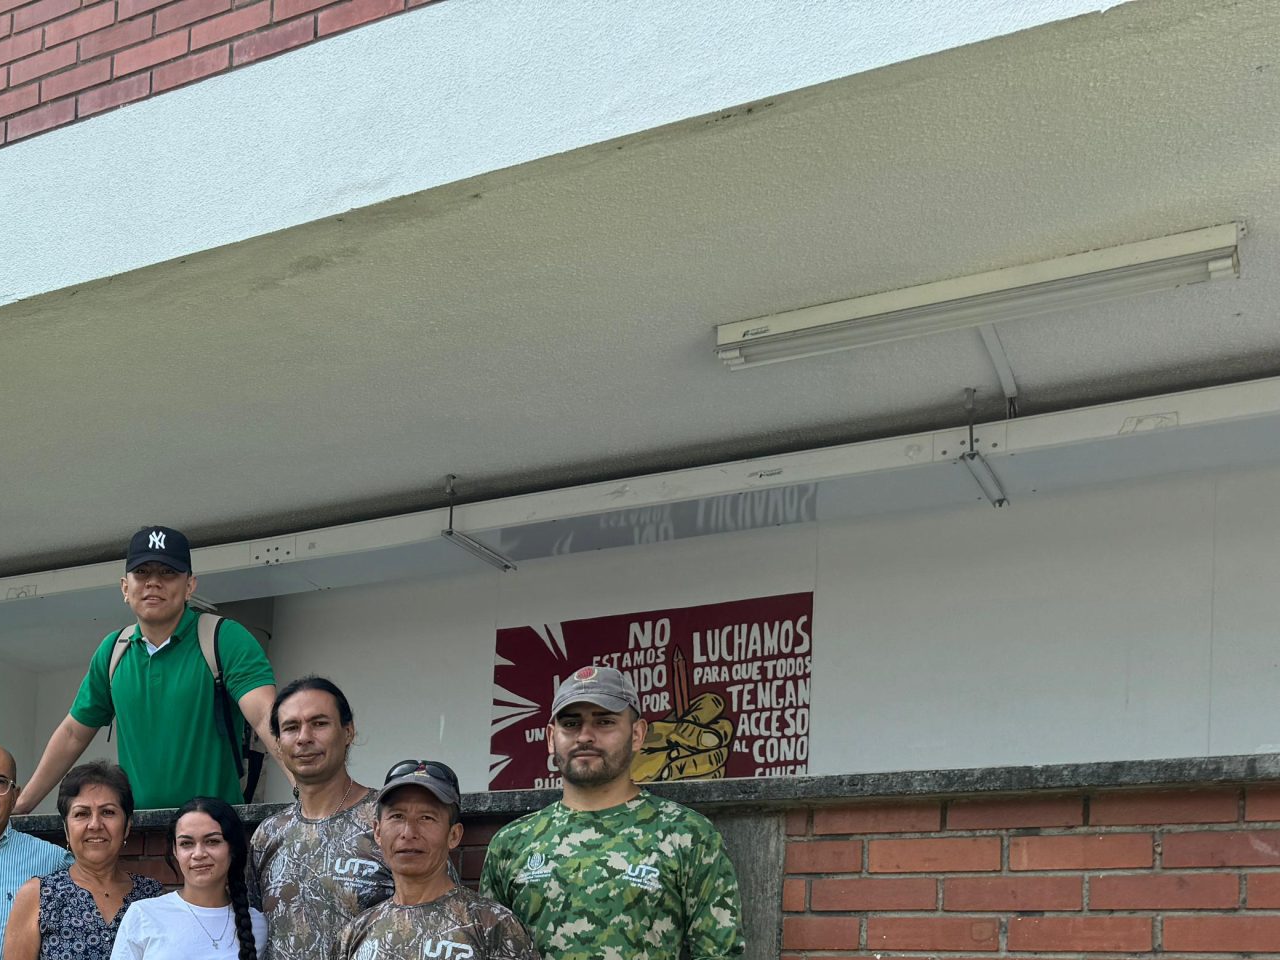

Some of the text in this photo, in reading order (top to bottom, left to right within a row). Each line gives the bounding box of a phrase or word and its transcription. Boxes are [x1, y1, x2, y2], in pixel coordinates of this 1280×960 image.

[148, 530, 166, 549] NY
[628, 617, 671, 649] NO
[692, 615, 810, 663] LUCHAMOS
[592, 647, 666, 669] ESTAMOS
[693, 655, 812, 685] PARA QUE TODOS
[642, 691, 671, 712] POR
[726, 678, 810, 712] TENGAN
[736, 708, 809, 737] ACCESO
[733, 735, 809, 763] AL CONO
[334, 857, 379, 877] UTP
[628, 863, 660, 879] UTP
